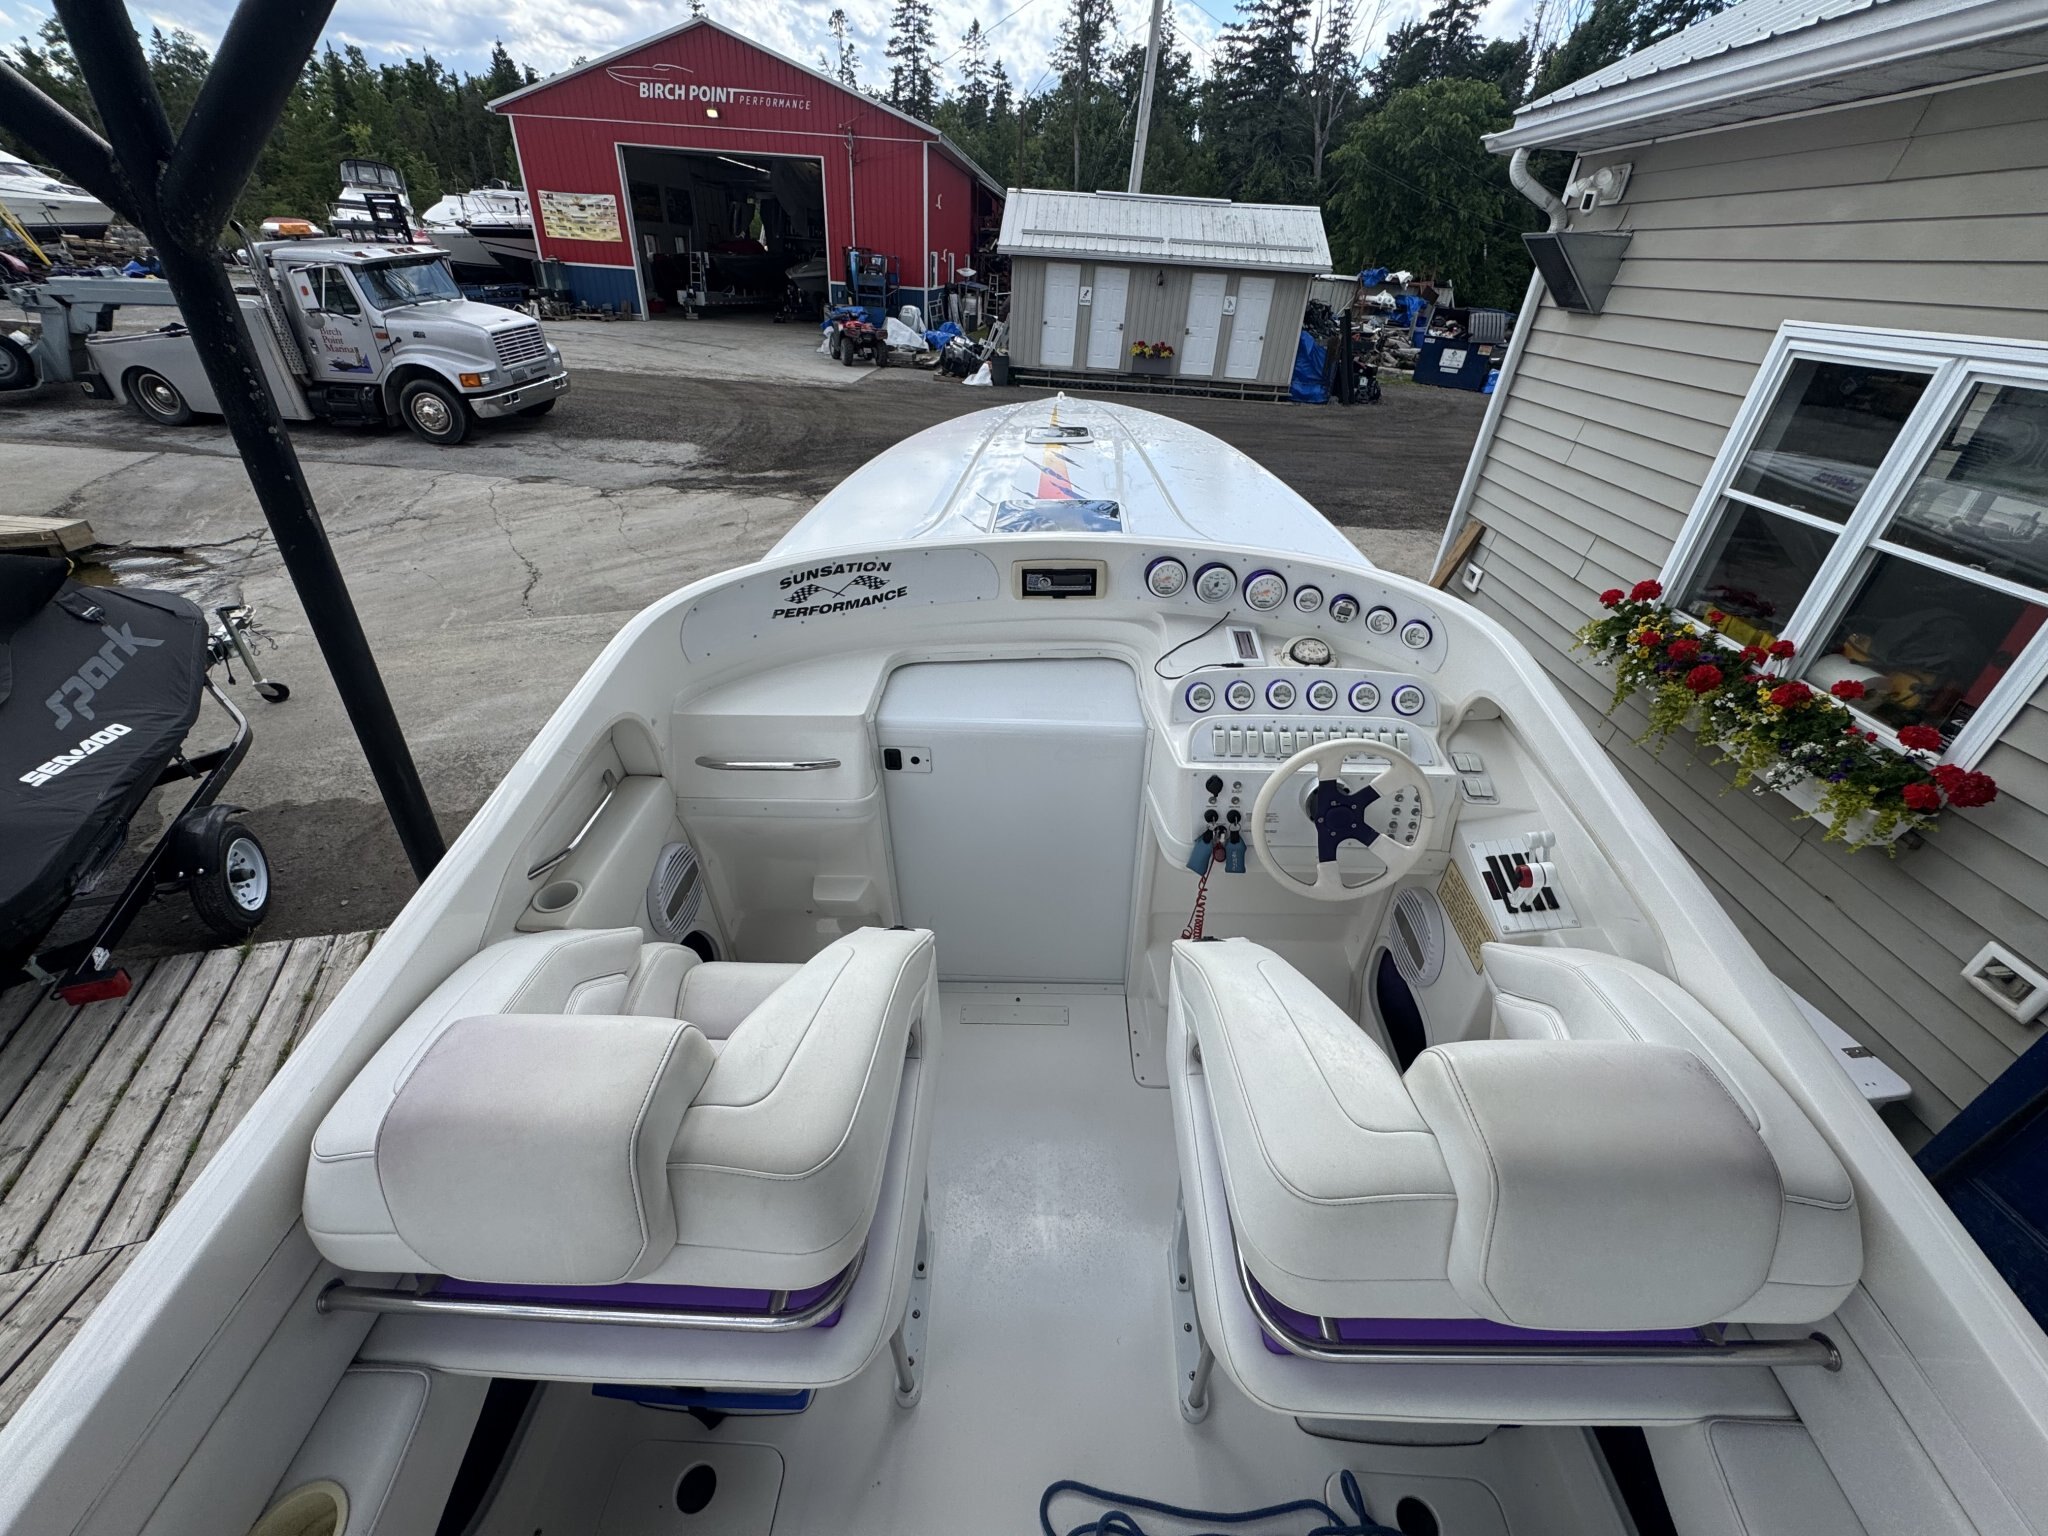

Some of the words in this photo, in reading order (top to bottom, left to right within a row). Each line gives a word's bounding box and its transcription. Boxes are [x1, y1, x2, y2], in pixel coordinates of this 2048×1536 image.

[639, 81, 686, 100] BIRCH
[689, 85, 737, 104] POINT
[739, 95, 811, 110] PERFORMANCE
[320, 327, 342, 336] Birch
[322, 335, 344, 345] Point
[324, 343, 355, 353] Marina
[779, 561, 892, 590] SUNSATION
[771, 586, 908, 619] PERFORMANCE
